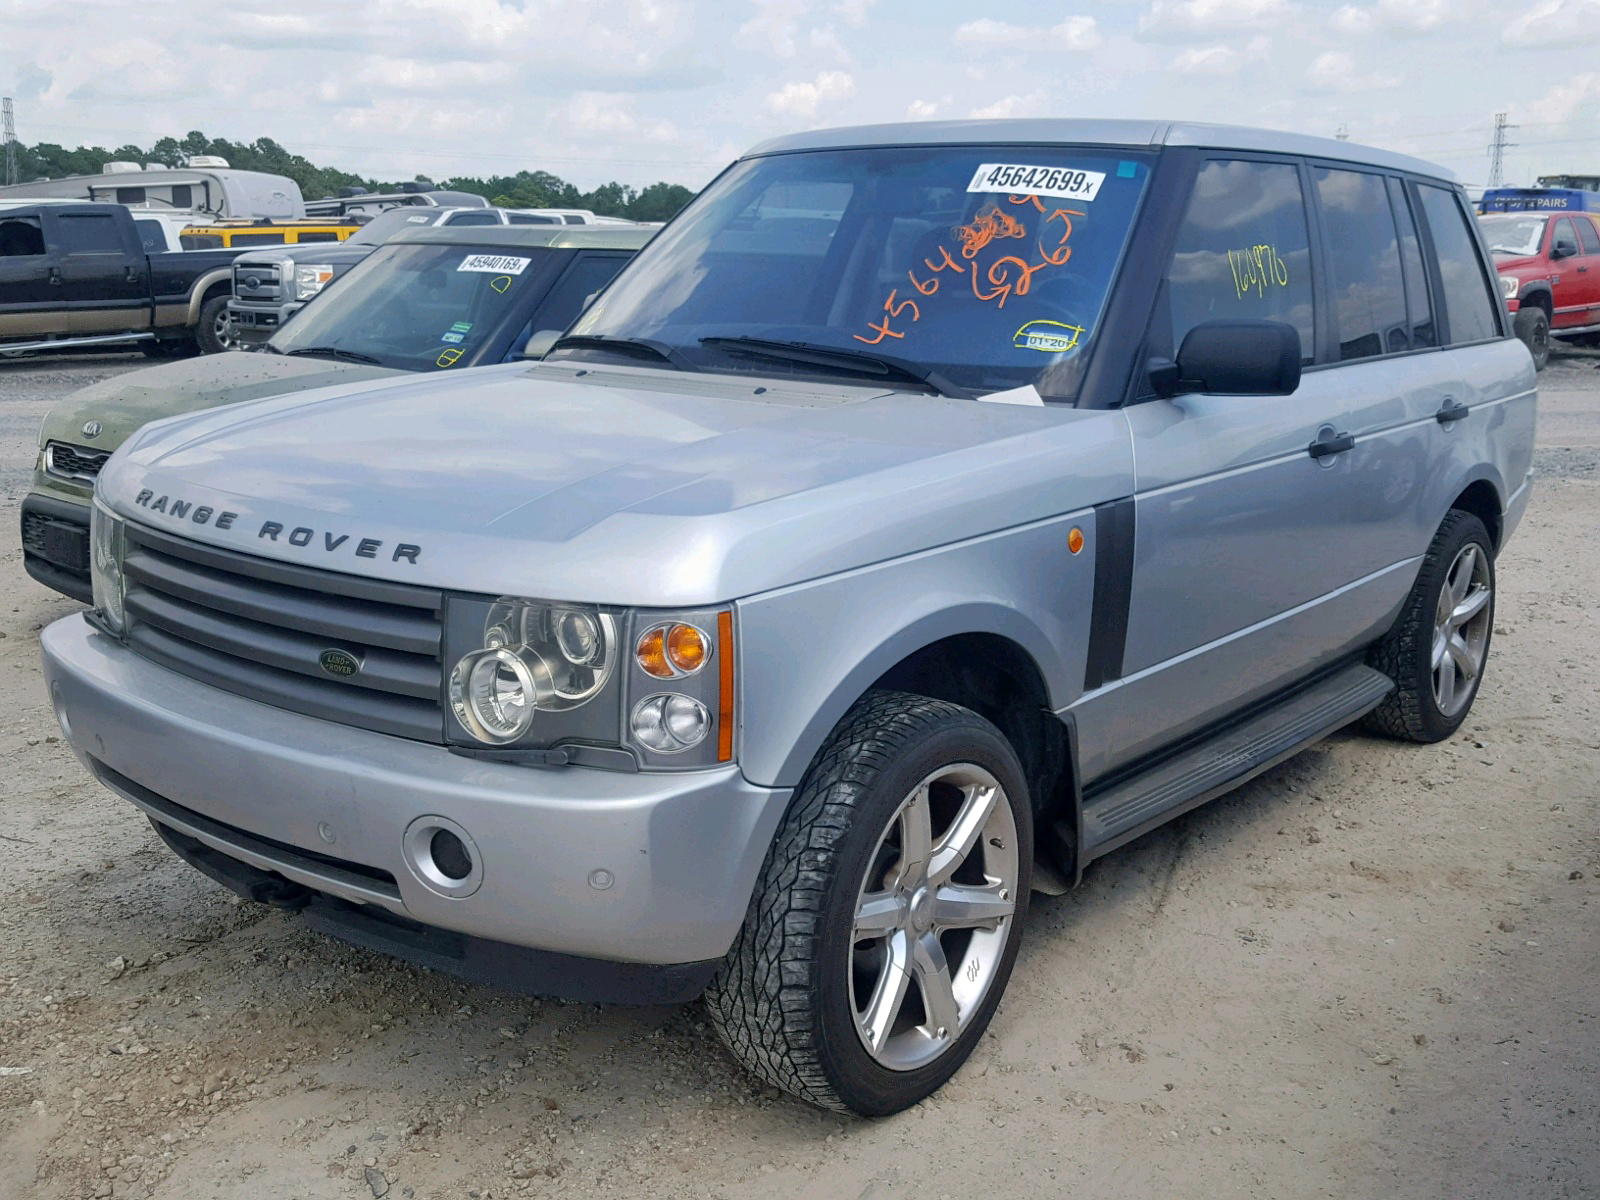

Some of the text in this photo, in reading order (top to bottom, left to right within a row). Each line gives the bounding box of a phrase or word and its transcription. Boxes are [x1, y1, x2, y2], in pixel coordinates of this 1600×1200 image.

[135, 488, 423, 565] RANGE ROVER
[329, 663, 352, 675] ROVER
